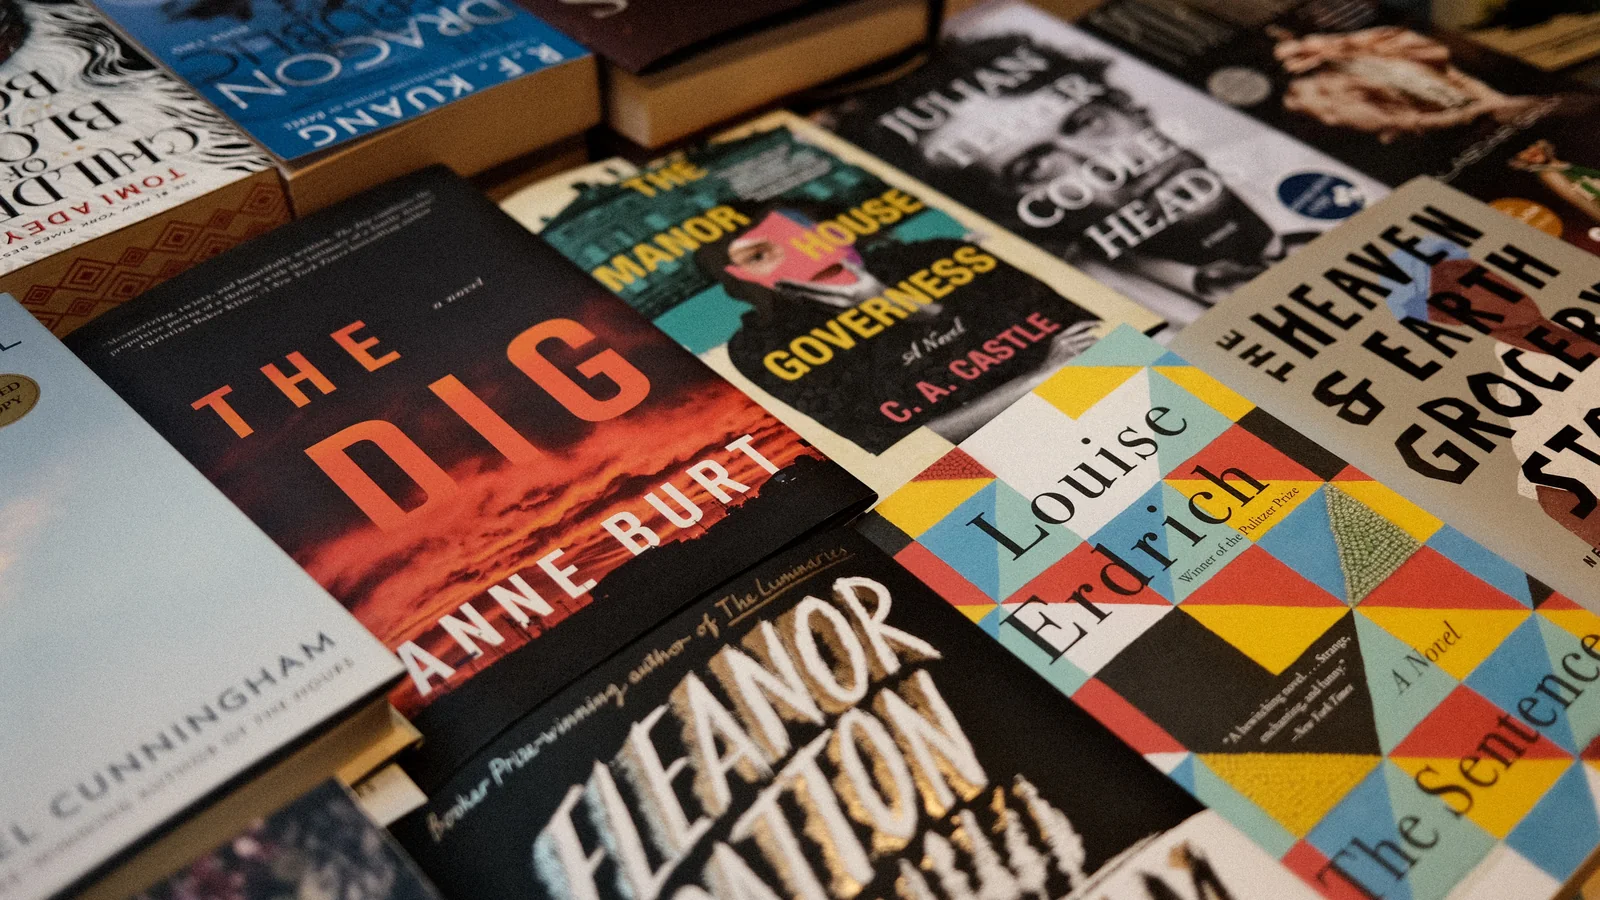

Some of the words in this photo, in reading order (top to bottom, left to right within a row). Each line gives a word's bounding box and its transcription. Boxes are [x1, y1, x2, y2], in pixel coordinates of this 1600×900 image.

[297, 74, 474, 147] KUANG
[879, 46, 1048, 146] JULIAN
[4, 201, 91, 246] ADEY
[81, 210, 117, 228] YORK
[100, 167, 188, 205] TOMI
[121, 196, 151, 213] NEW
[621, 159, 709, 198] THE
[34, 227, 76, 247] TIMES
[593, 204, 750, 293] MANOR
[790, 188, 927, 262] HOUSE
[1250, 206, 1484, 359] HEAVEN
[432, 300, 443, 311] a
[444, 276, 484, 302] novel
[763, 245, 998, 381] GOVERNESS
[922, 316, 966, 352] Novel
[1312, 370, 1385, 426] &
[1361, 244, 1560, 381] EARTH
[190, 320, 402, 439] THE
[880, 400, 922, 424] C.
[916, 380, 958, 404] A.
[949, 312, 1061, 381] CASTLE
[1216, 329, 1295, 384] THE
[304, 317, 652, 534] DIG
[966, 406, 1187, 561] Louise
[397, 548, 598, 698] ANNE
[600, 433, 781, 557] BURT
[999, 463, 1270, 665] Erdrich
[1178, 555, 1216, 584] Winner
[1215, 543, 1227, 557] of
[1226, 533, 1243, 549] the
[1238, 505, 1277, 536] Pulitzer
[1272, 486, 1300, 508] Prize
[628, 633, 693, 685] author
[696, 611, 720, 641] of
[714, 592, 758, 620] The
[755, 546, 849, 597] Luminaries
[1390, 669, 1411, 697] A
[1404, 619, 1463, 677] Novel
[50, 630, 336, 820] CUNNINGHAM
[1235, 693, 1287, 735] bewitching
[1315, 636, 1351, 664] Strange,
[1304, 684, 1321, 703] and
[1311, 701, 1333, 722] York
[1328, 683, 1354, 706] Times
[533, 576, 942, 900] ELEANOR
[672, 669, 988, 900] TTON
[1315, 813, 1439, 900] The
[1414, 633, 1600, 820] Sentence
